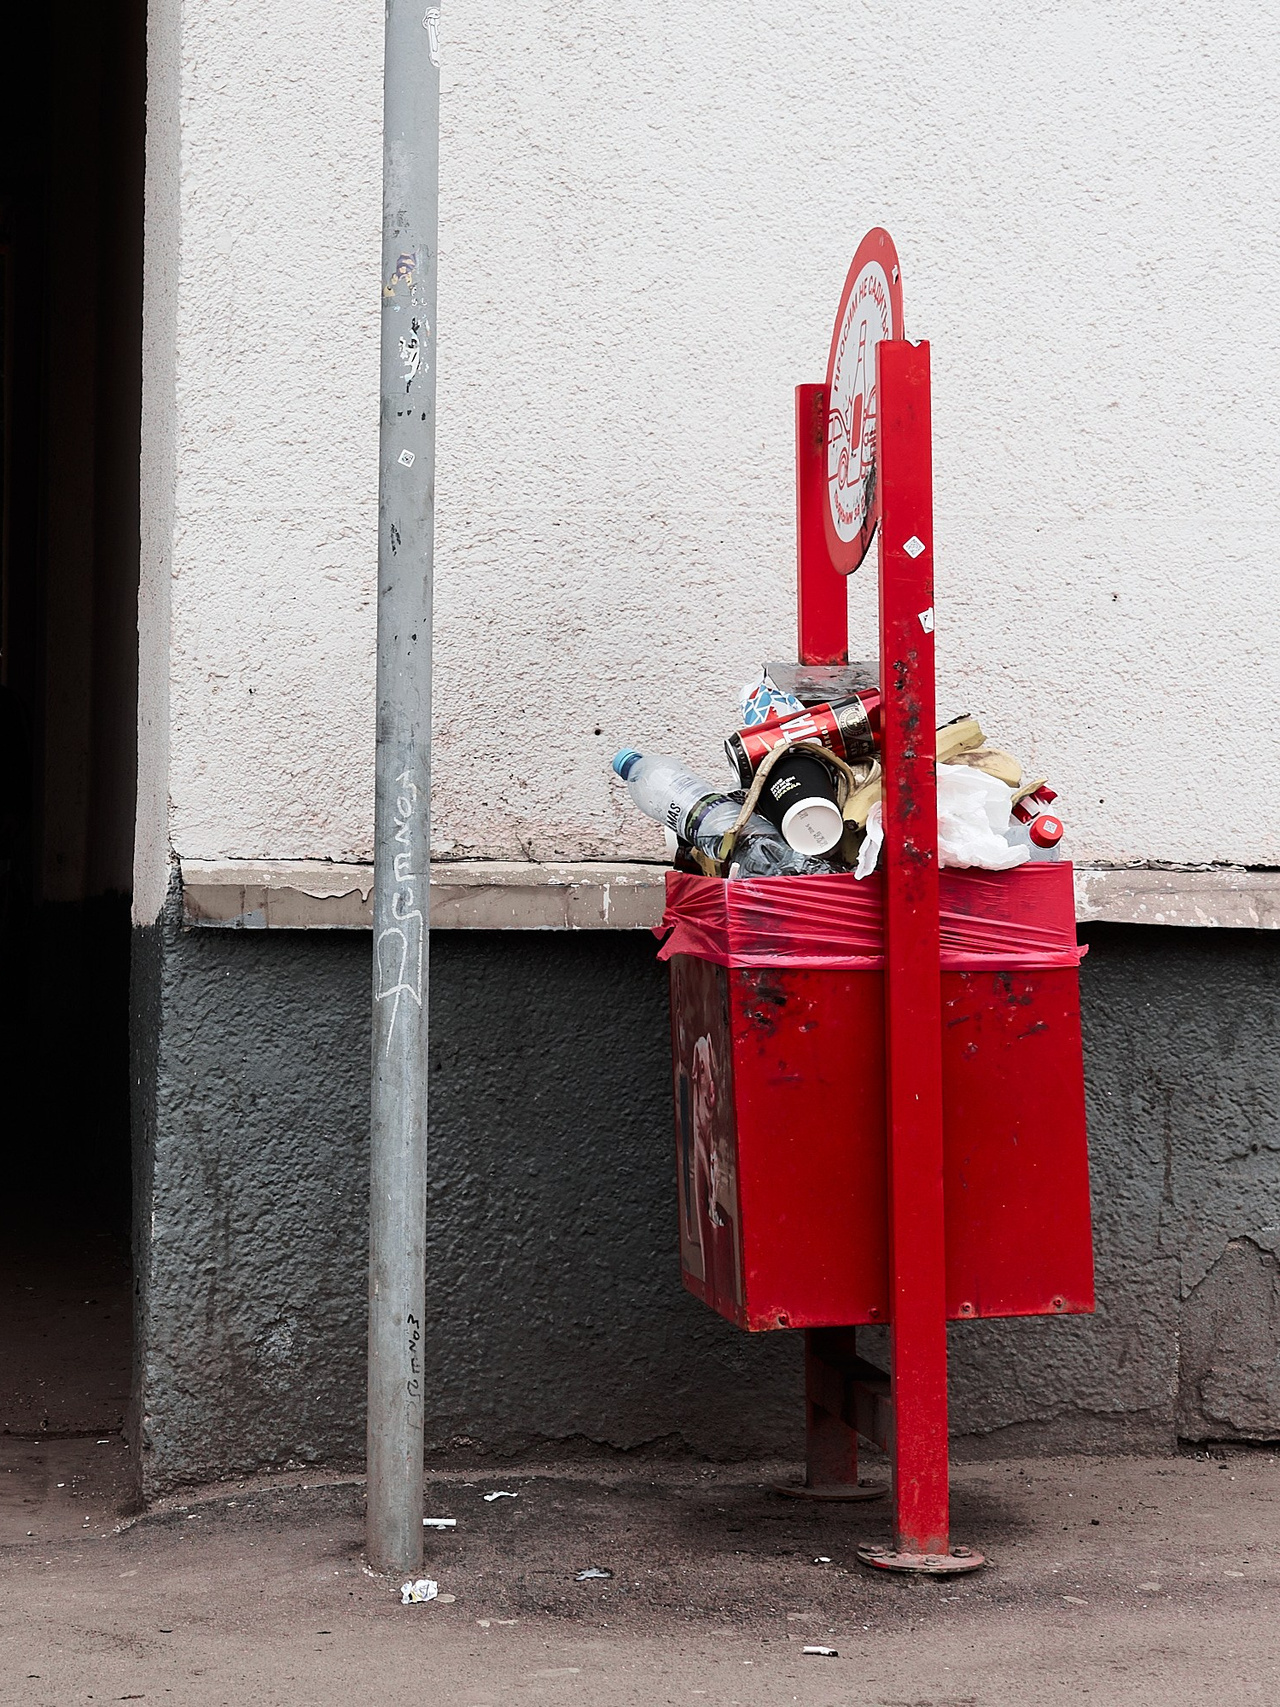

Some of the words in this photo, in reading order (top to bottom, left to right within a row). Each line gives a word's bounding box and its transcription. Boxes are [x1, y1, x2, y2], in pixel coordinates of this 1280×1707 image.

[834, 293, 858, 392] ПРОСИМ
[858, 277, 869, 303] НЕ
[868, 275, 889, 340] САДИТЬС
